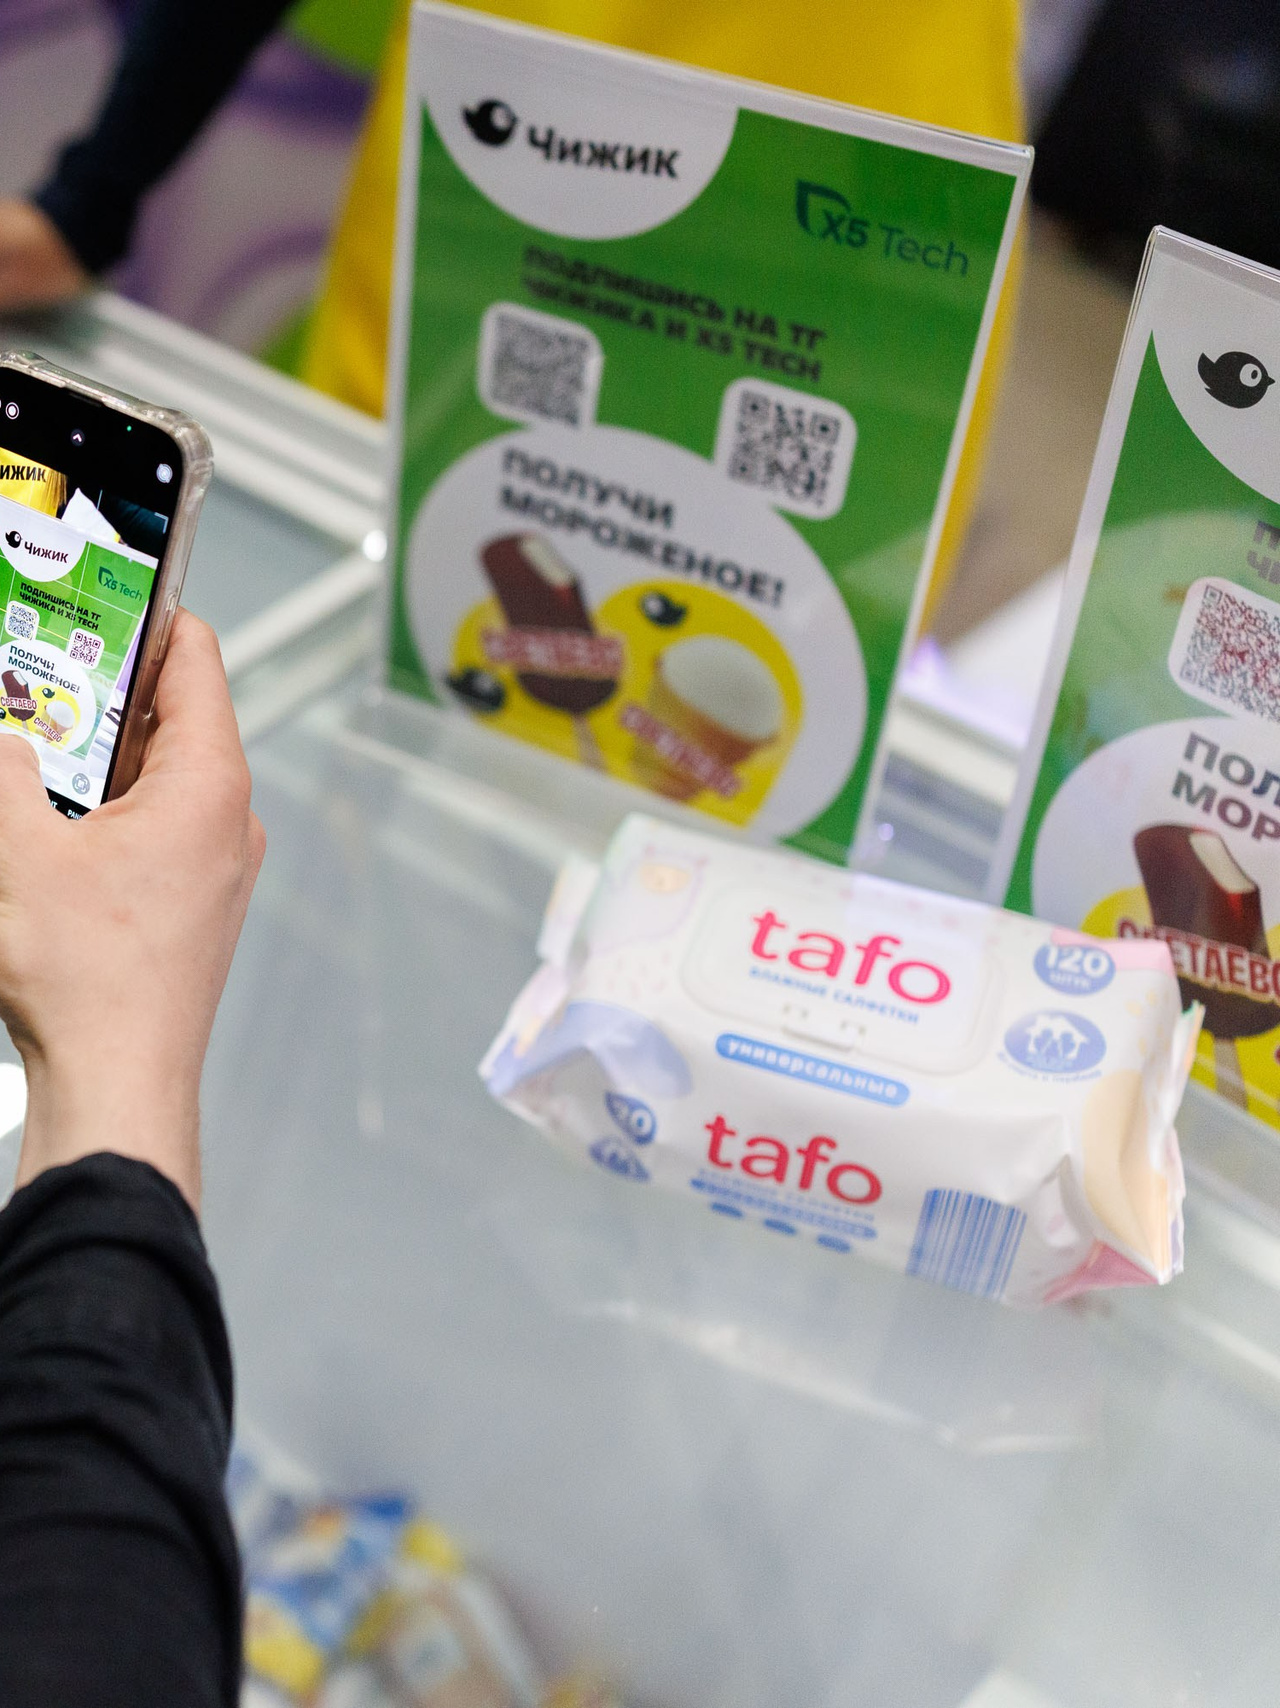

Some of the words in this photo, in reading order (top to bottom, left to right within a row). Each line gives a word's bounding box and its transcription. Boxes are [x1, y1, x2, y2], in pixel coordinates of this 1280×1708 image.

[527, 127, 679, 179] Чижик
[879, 224, 969, 277] Tech
[734, 307, 777, 337] НА
[790, 323, 825, 349] ТГ
[745, 340, 821, 382] TECH
[504, 448, 673, 529] ПОЛУЧИ
[24, 541, 68, 563] Чижик
[501, 487, 785, 608] МОРОЖЕНОЕ!
[19, 591, 56, 613] ЧИЖИКА
[57, 608, 65, 617] И
[78, 616, 99, 631] TECH
[20, 582, 75, 610] ПОДПИШИСЬ
[76, 605, 89, 617] НА
[91, 612, 102, 621] ТГ
[120, 583, 143, 601] Tech
[8, 656, 80, 693] МОРОЖЕНОЕ!
[10, 645, 55, 671] ПОЛУЧИ
[0, 697, 37, 710] СВЕТАЕВО
[751, 911, 952, 1004] tafo
[1046, 945, 1110, 978] 120
[750, 966, 828, 997] ВЛАЖНЫЕ
[833, 989, 919, 1024] САЛФЕТКИ
[728, 1039, 898, 1099] универсальные
[704, 1115, 883, 1205] tafo
